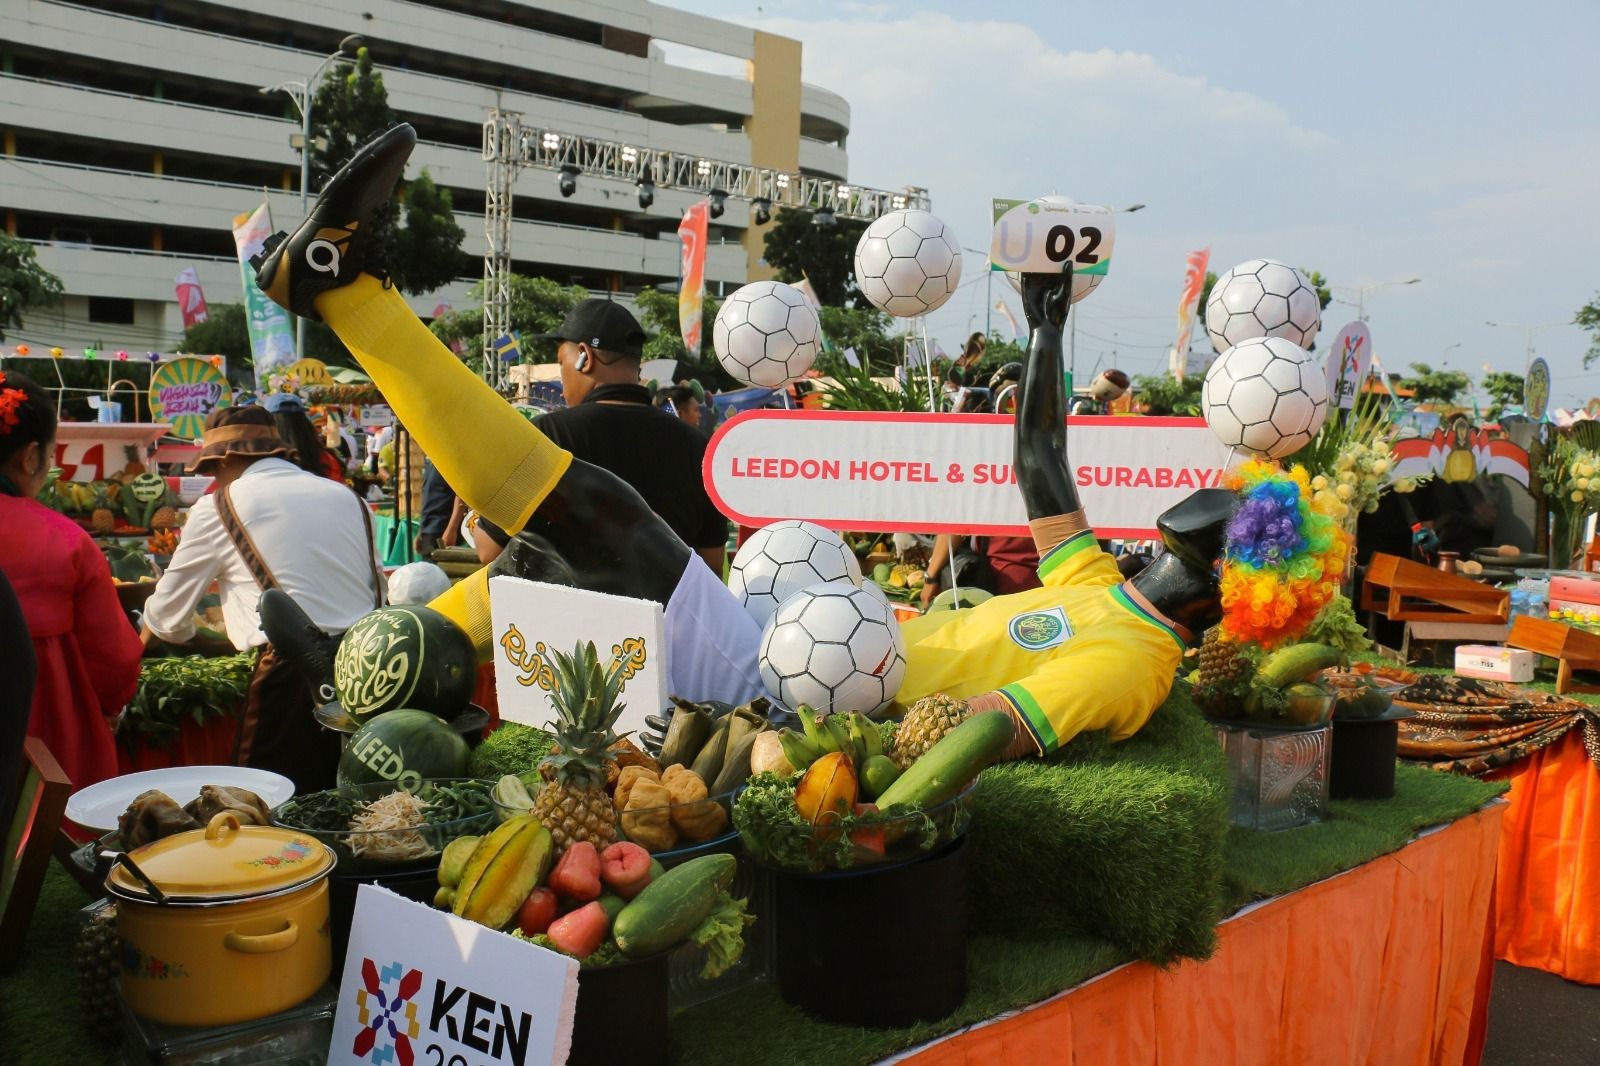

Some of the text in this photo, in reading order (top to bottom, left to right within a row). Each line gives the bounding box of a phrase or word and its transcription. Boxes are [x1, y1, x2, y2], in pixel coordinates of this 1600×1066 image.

[1000, 221, 1103, 264] U 02
[731, 457, 841, 480] LEEDON
[849, 460, 939, 483] HOTEL
[946, 463, 965, 484] &
[972, 463, 1018, 485] SUI
[352, 731, 425, 795] LEEDO
[428, 978, 533, 1066] KEN
